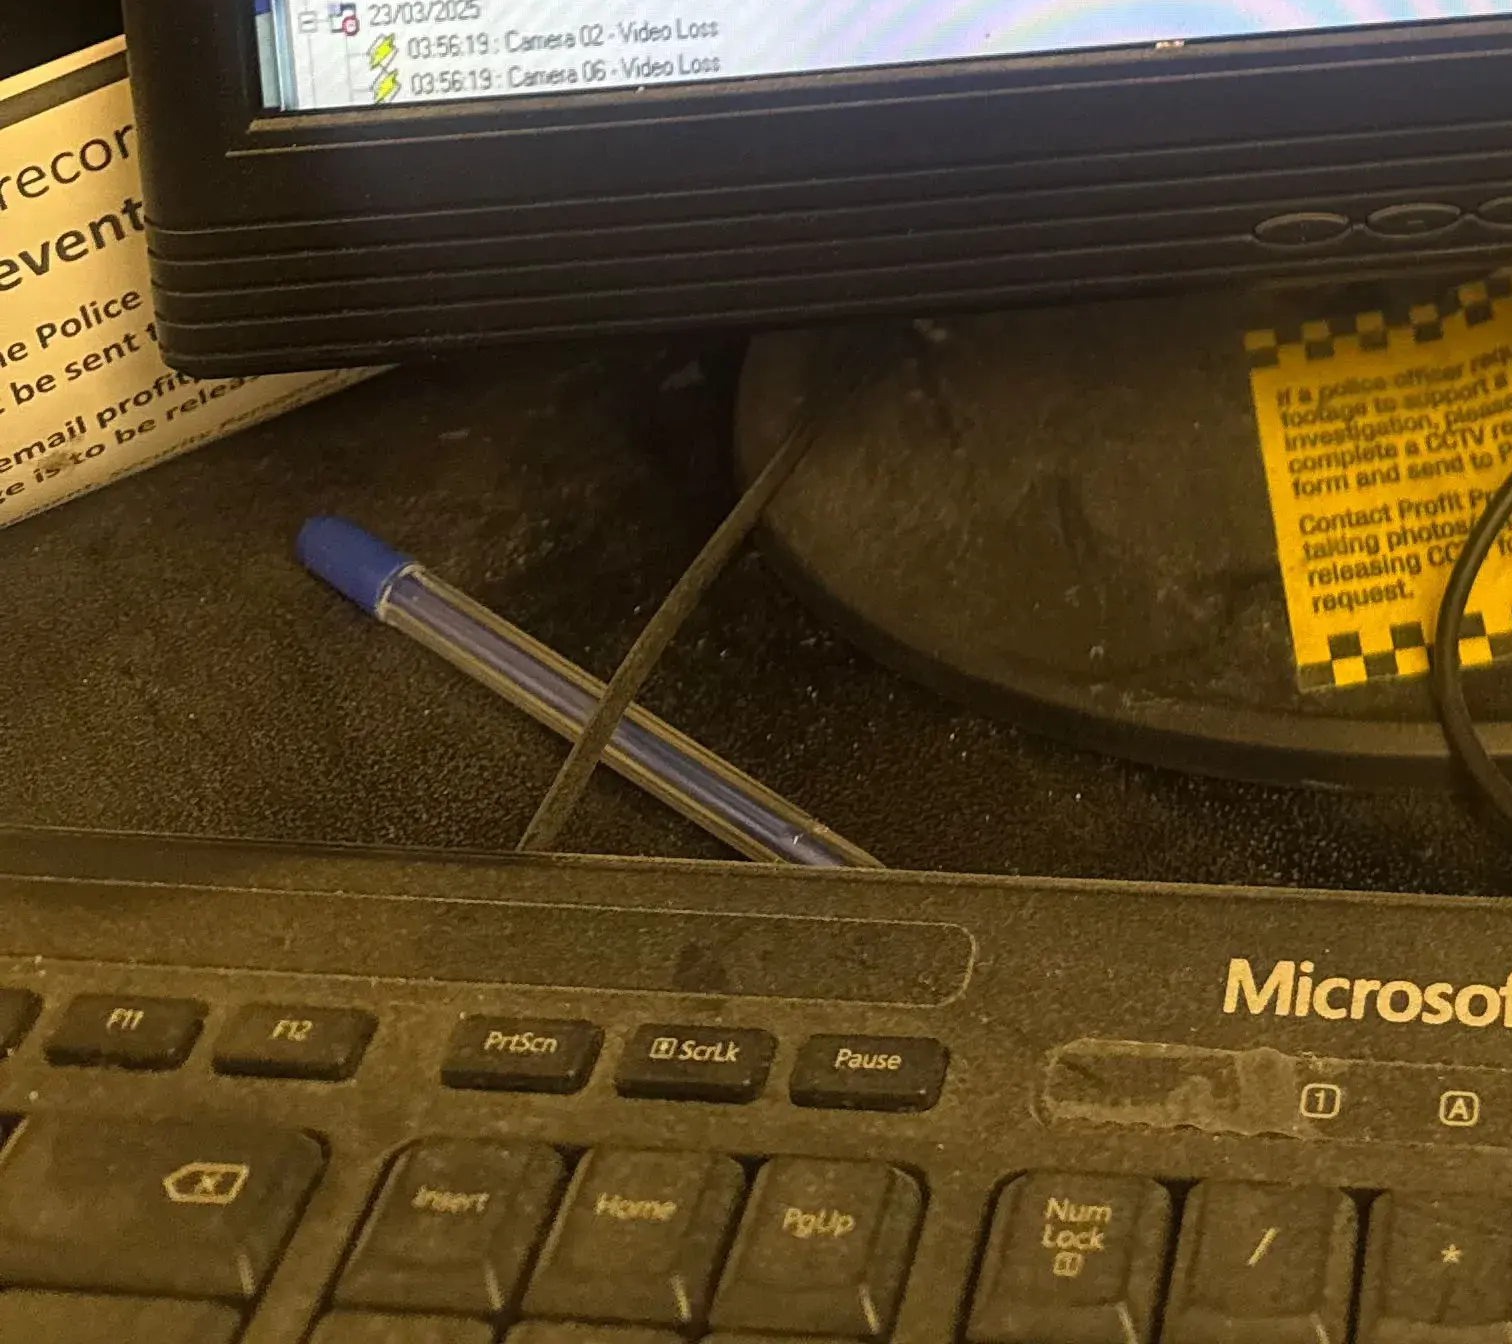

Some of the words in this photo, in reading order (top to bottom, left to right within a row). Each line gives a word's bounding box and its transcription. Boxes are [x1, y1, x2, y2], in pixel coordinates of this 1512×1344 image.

[407, 31, 490, 61] 03:56:19
[504, 29, 577, 55] Camera
[580, 24, 604, 48] 02
[617, 20, 672, 45] Video
[676, 16, 720, 41] Loss
[411, 67, 494, 96] 03:56:19
[507, 64, 578, 91] Camera
[582, 59, 607, 83] 06
[621, 55, 674, 81] Video
[679, 53, 721, 77] Loss
[36, 286, 143, 349] Police
[10, 372, 57, 406] be
[64, 332, 140, 382] sent
[1317, 375, 1388, 411] police
[1393, 361, 1463, 388] officer
[1281, 400, 1368, 428] footage
[1373, 396, 1398, 413] to
[1403, 376, 1490, 411] support
[0, 415, 87, 474] email
[33, 468, 61, 484] is
[69, 442, 106, 465] to
[115, 418, 157, 445] be
[1289, 441, 1399, 475] complete
[1405, 439, 1420, 456] a
[1425, 424, 1485, 453] CCTV
[1292, 474, 1349, 499] form
[1356, 463, 1400, 488] and
[1407, 452, 1465, 480] send
[1470, 450, 1494, 470] to
[1300, 503, 1392, 535] Contact
[1397, 490, 1464, 520] Profit
[1302, 532, 1381, 561] taking
[1308, 552, 1422, 588] releasing
[1312, 578, 1415, 613] request.
[106, 1008, 145, 1032] F11
[271, 1018, 315, 1042] F12
[482, 1030, 559, 1055] PrtScn
[677, 1036, 740, 1066] ScrLk
[833, 1047, 903, 1073] Pause
[1448, 1098, 1471, 1122] A
[410, 1185, 491, 1216] Insert
[595, 1194, 679, 1224] Home
[1045, 1197, 1113, 1223] Num
[782, 1208, 857, 1241] PgUp
[1040, 1223, 1106, 1250] Lock
